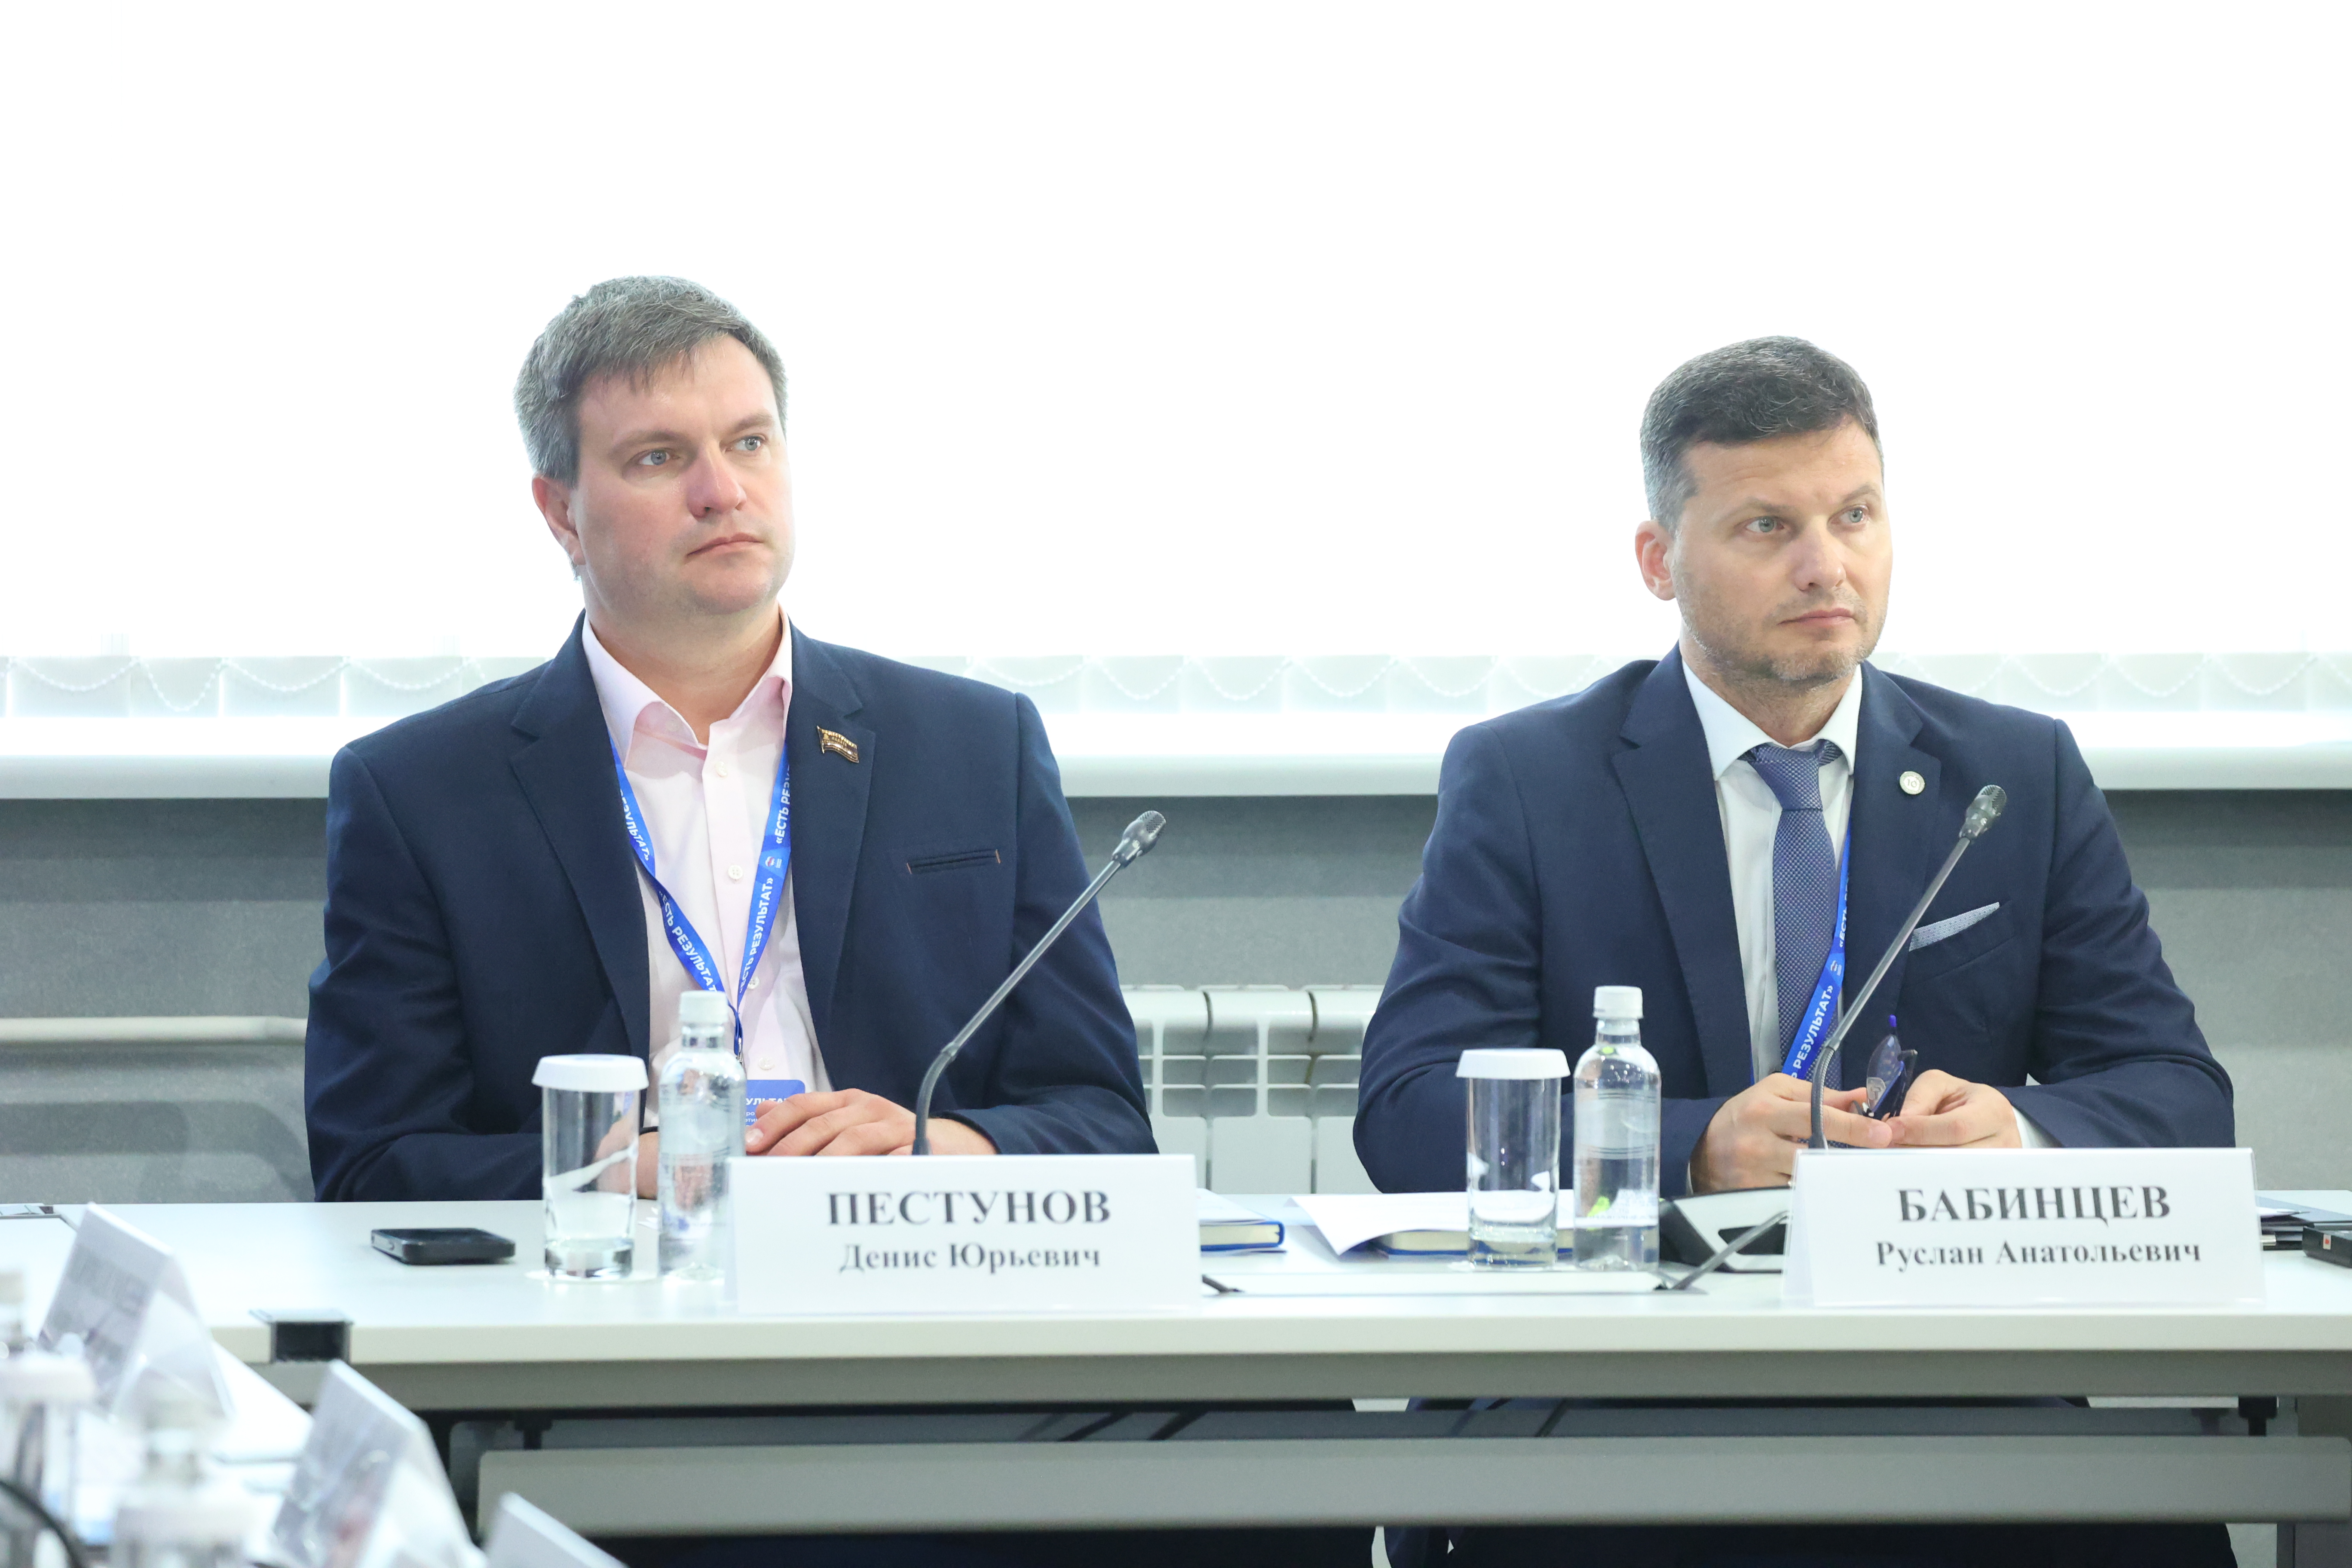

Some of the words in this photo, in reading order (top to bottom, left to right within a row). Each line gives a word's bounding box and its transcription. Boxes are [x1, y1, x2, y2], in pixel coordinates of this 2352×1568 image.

[620, 789, 650, 861] ЗУЛЬТАТ»
[775, 807, 789, 844] «ЕСТЬ
[658, 891, 674, 927] «ЕСТЬ
[739, 957, 754, 993] «ЕСТЬ
[749, 877, 774, 956] РЕЗУЛЬТАТ»
[1792, 985, 1833, 1069] РЕЗУЛЬТАТ»
[828, 1190, 1110, 1225] ПЕСТУНОВ
[1897, 1185, 2171, 1226] БАБИНЦЕВ
[839, 1244, 936, 1274] Денис
[949, 1243, 1099, 1275] Юрьевич
[1876, 1241, 1984, 1272] Руслан
[1996, 1240, 2201, 1264] Анатольевич
